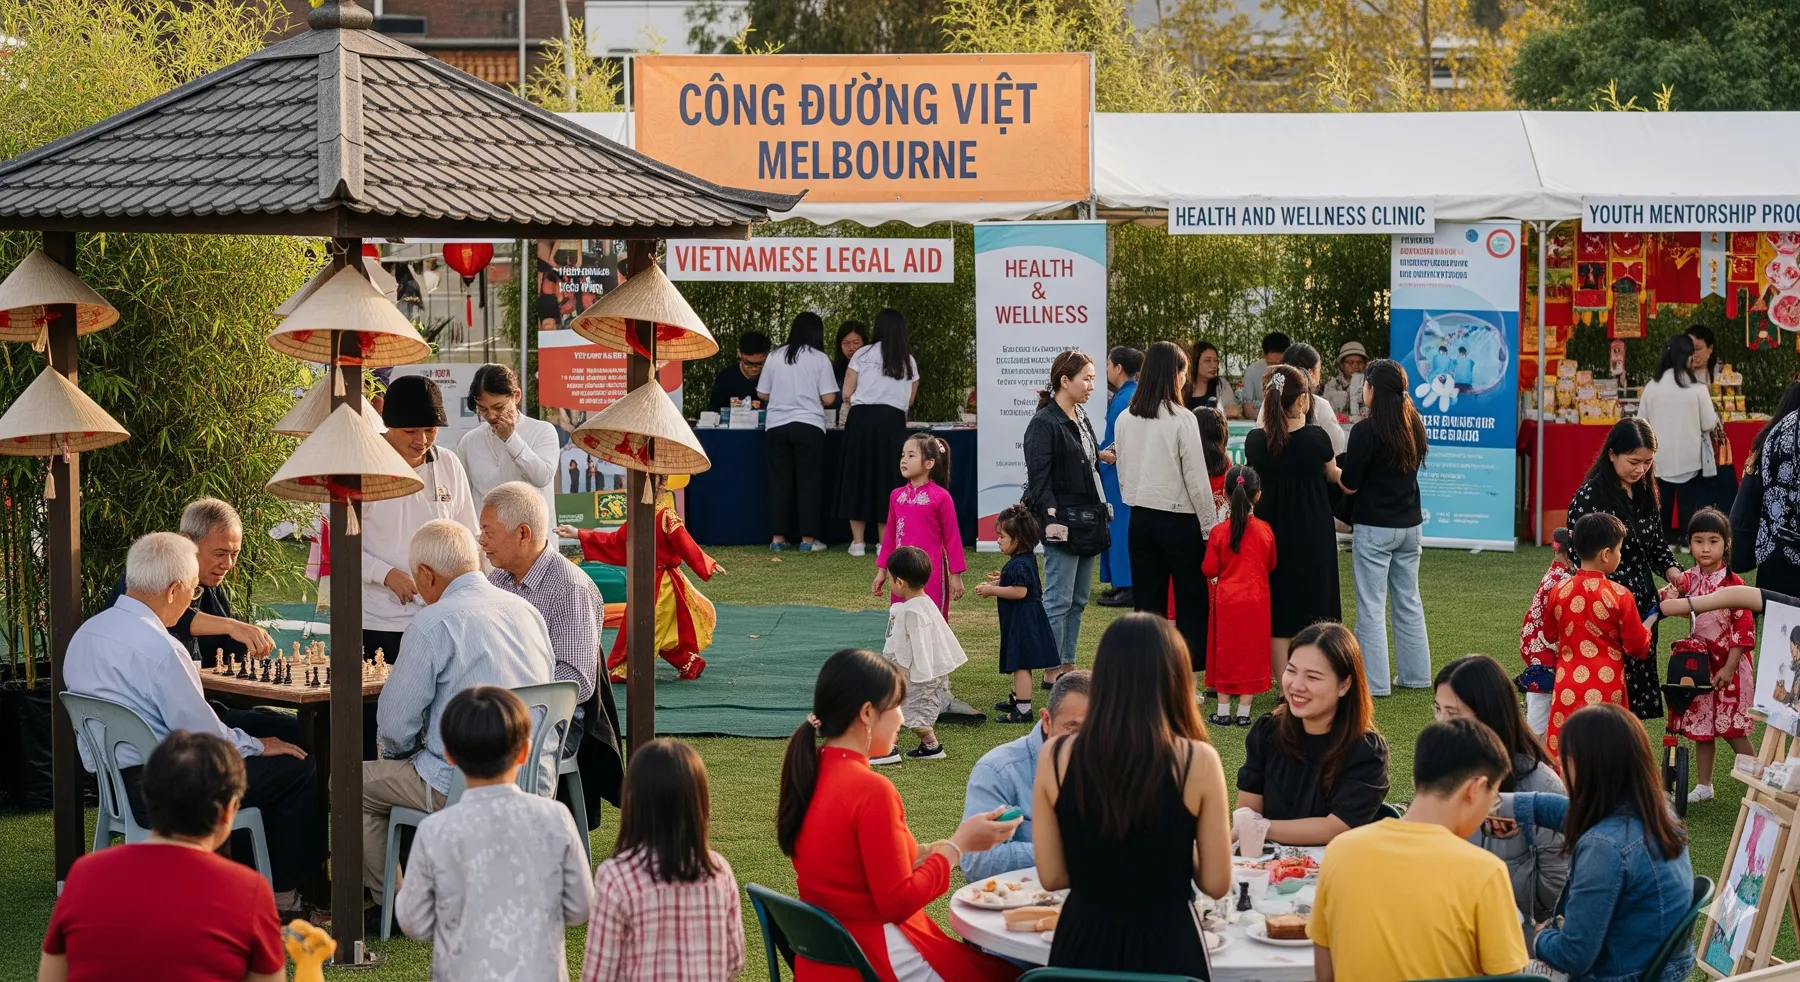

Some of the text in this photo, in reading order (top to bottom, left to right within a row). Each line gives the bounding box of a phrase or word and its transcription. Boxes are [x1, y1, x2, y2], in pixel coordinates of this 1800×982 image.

[679, 71, 1038, 134] CÔNG ĐƯỜNG VIỆT
[758, 140, 978, 180] MELBOURNE
[1176, 205, 1426, 226] HEALTH AND WELLNESS CLINIC
[1589, 204, 1644, 224] YOUTH
[1649, 203, 1757, 224] MENTORSHIP
[674, 246, 942, 273] VIETNAMESE LEGAL AID
[1005, 259, 1073, 278] HEALTH
[1031, 281, 1046, 300] &
[995, 305, 1089, 324] WELLNESS
